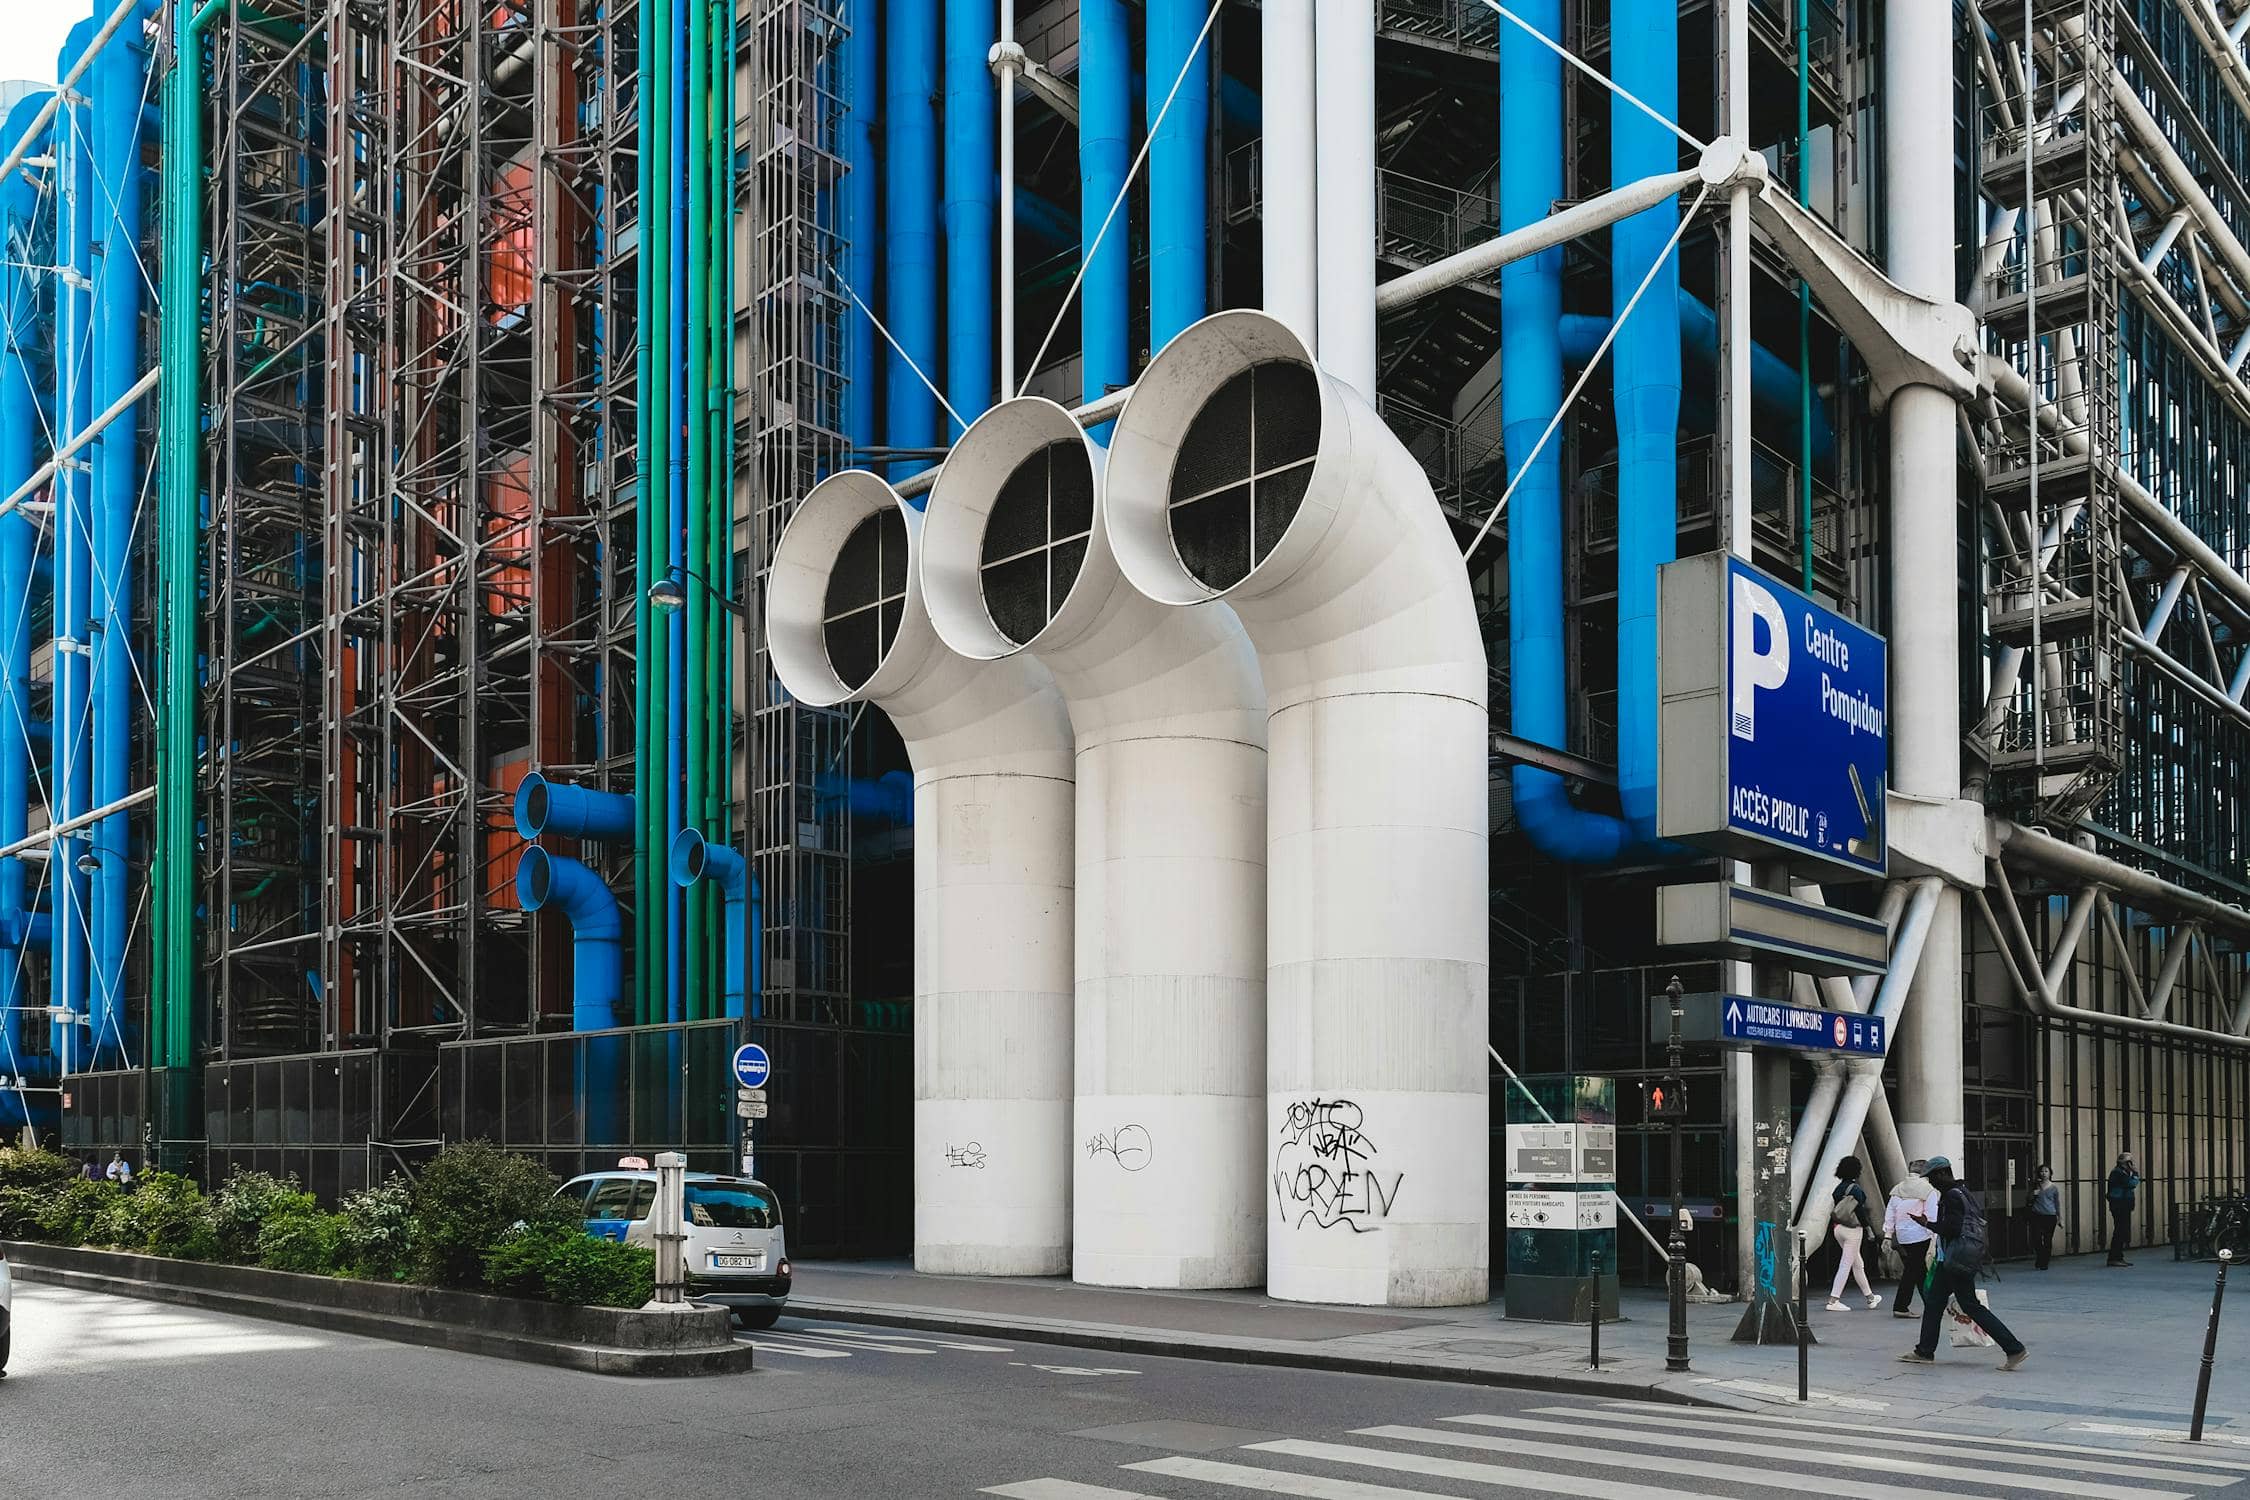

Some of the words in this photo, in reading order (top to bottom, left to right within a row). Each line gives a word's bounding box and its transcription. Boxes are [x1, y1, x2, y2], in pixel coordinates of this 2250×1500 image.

[1732, 572, 1790, 742] P
[1804, 612, 1849, 672] Centre
[1821, 671, 1883, 739] Pompidou
[1732, 784, 1769, 827] ACCÈS
[1771, 797, 1810, 839] PUBLIC
[1746, 1004, 1781, 1026] AUTOCARS
[1785, 1009, 1823, 1032] LIVRAISONS
